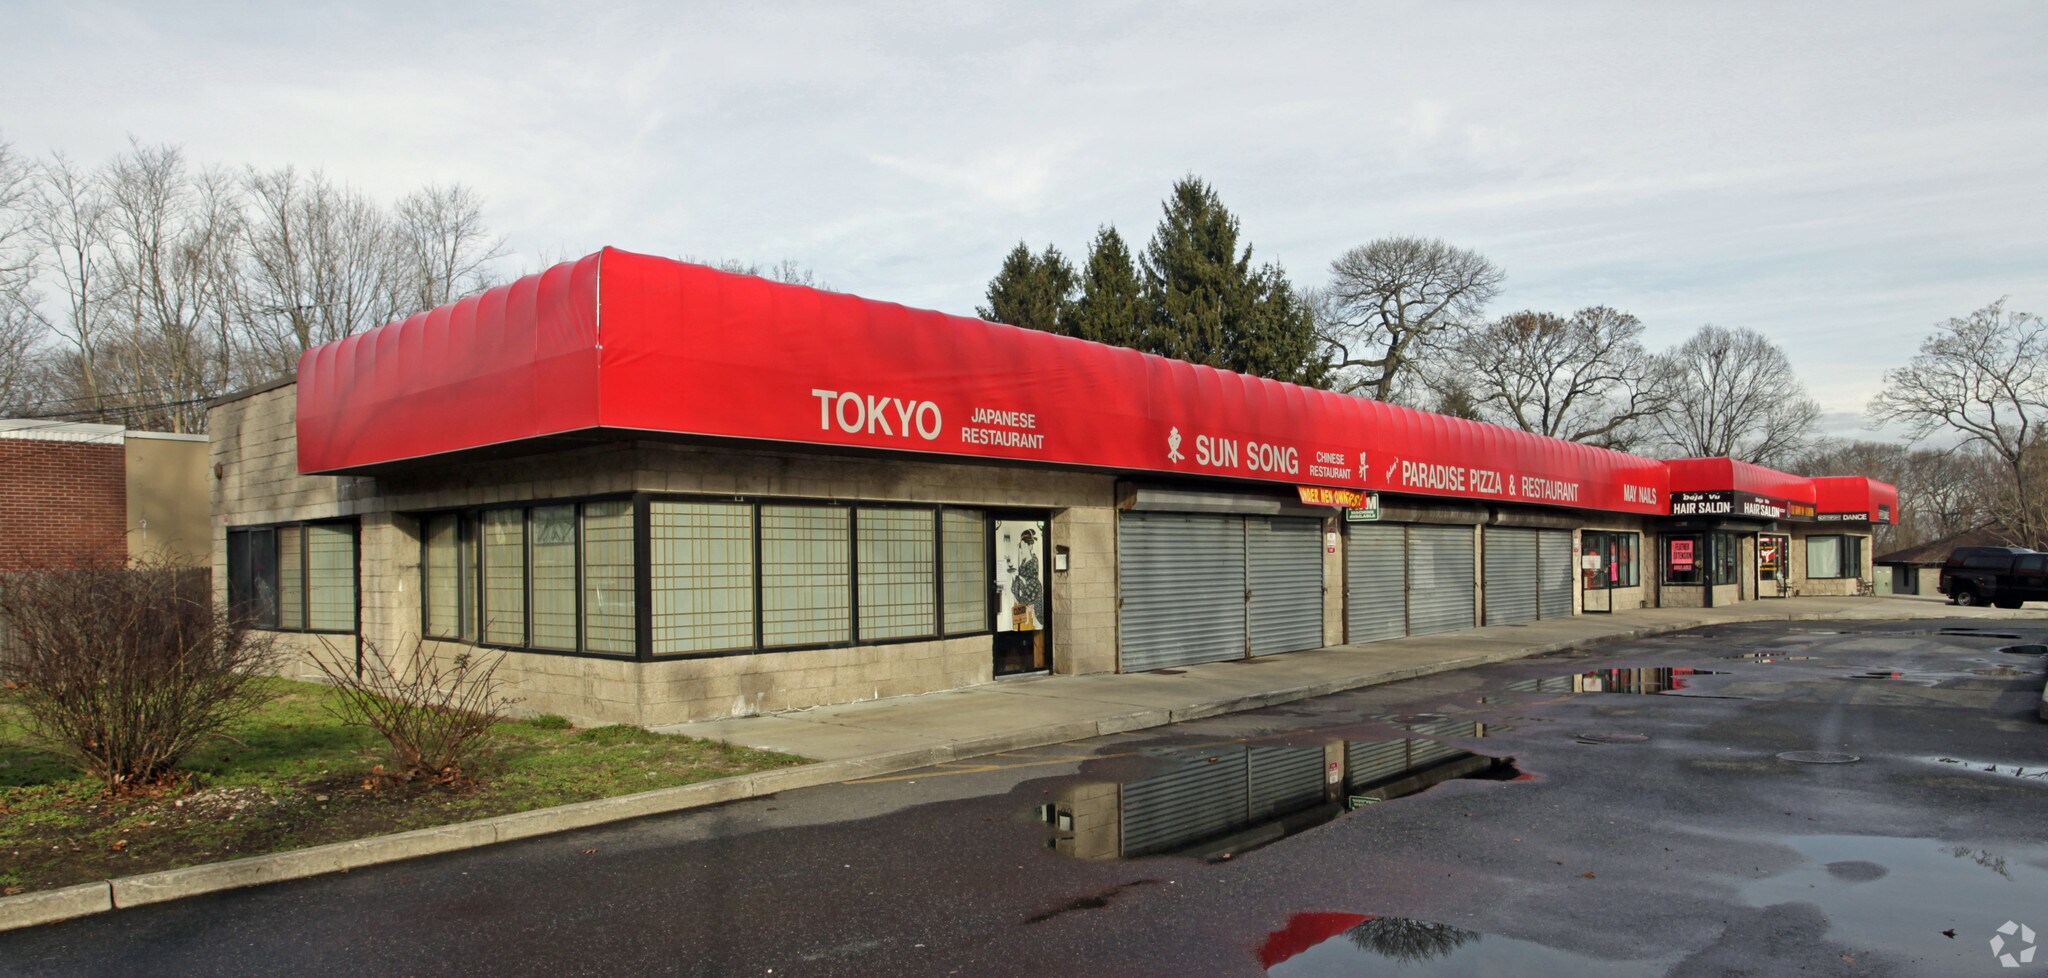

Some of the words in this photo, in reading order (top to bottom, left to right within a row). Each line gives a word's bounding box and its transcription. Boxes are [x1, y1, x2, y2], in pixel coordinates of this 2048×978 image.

[812, 389, 942, 440] TOKYO
[971, 408, 1036, 429] JAPANESE
[961, 427, 1044, 449] RESTAURANT
[1195, 434, 1238, 468] SUN
[1246, 441, 1299, 475] SONG
[1316, 451, 1345, 465] CHINESE
[1309, 464, 1351, 480] RESTAURANT
[1402, 460, 1465, 491] PARADISE
[1470, 469, 1502, 494] PIZZA
[1509, 474, 1516, 496] &
[1522, 476, 1579, 502] RESTAURANT
[1623, 483, 1637, 502] MAY
[1638, 485, 1657, 505] NAILS
[1673, 502, 1696, 514] HAIR
[1698, 501, 1731, 513] SALON
[1744, 502, 1760, 514] HAIR
[1760, 504, 1780, 517] SALON
